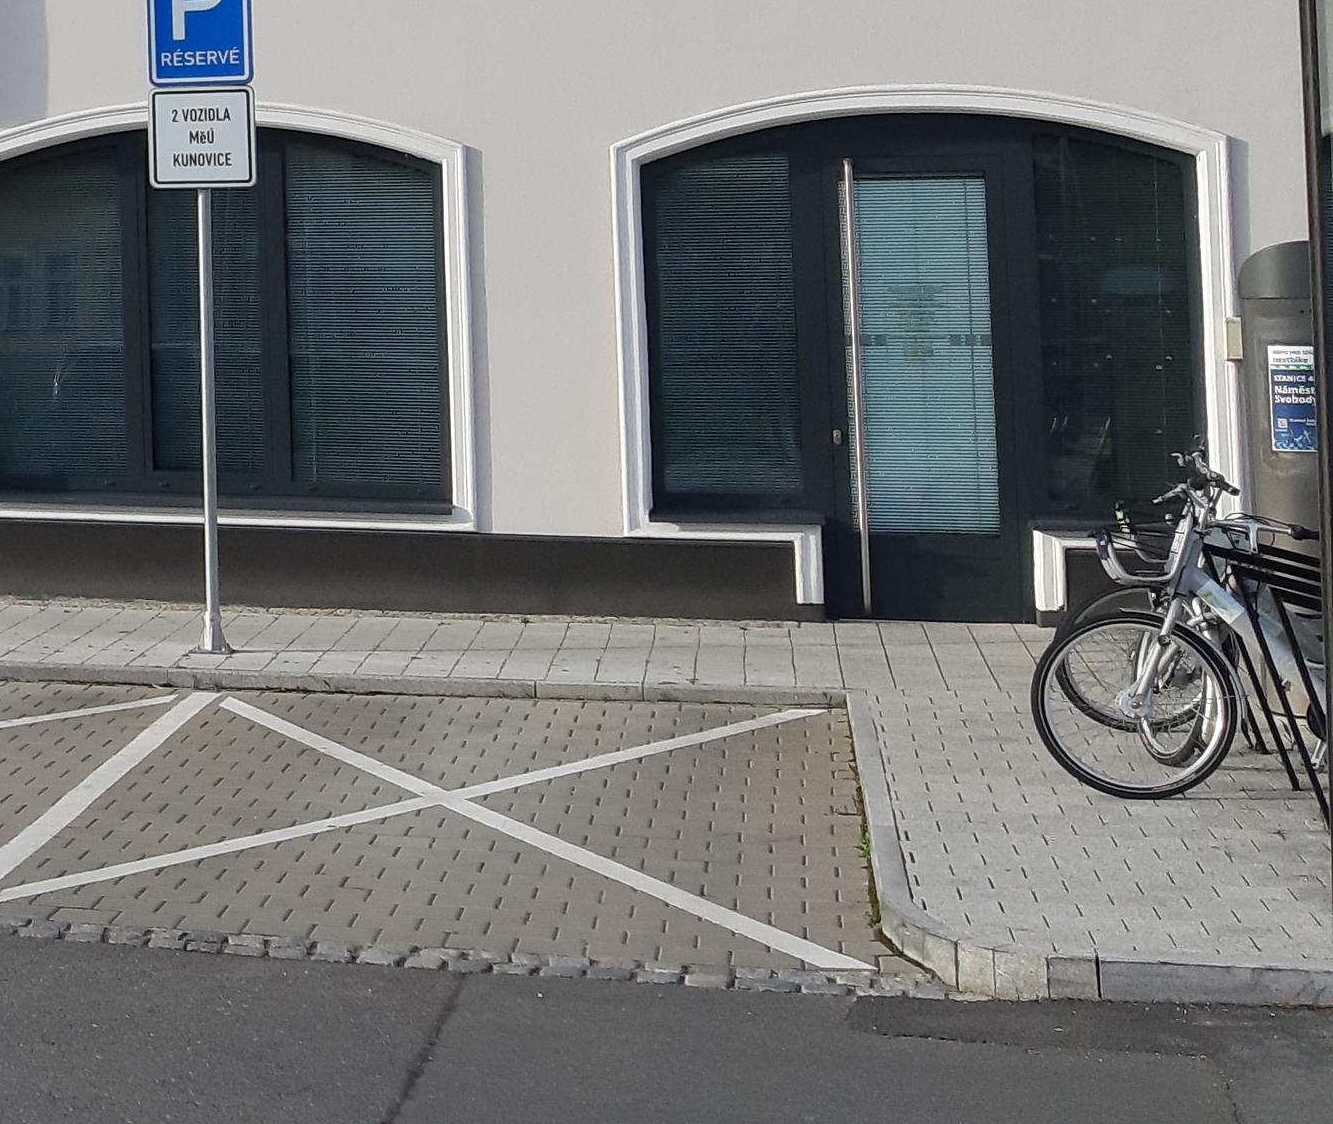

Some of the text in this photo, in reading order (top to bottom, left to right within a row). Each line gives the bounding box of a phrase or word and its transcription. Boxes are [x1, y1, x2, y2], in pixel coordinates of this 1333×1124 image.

[161, 47, 240, 67] RÉSERVÉ
[171, 107, 231, 123] 2 VOZIDLA
[189, 128, 215, 144] MěÚ
[173, 152, 232, 167] KUNOVICE
